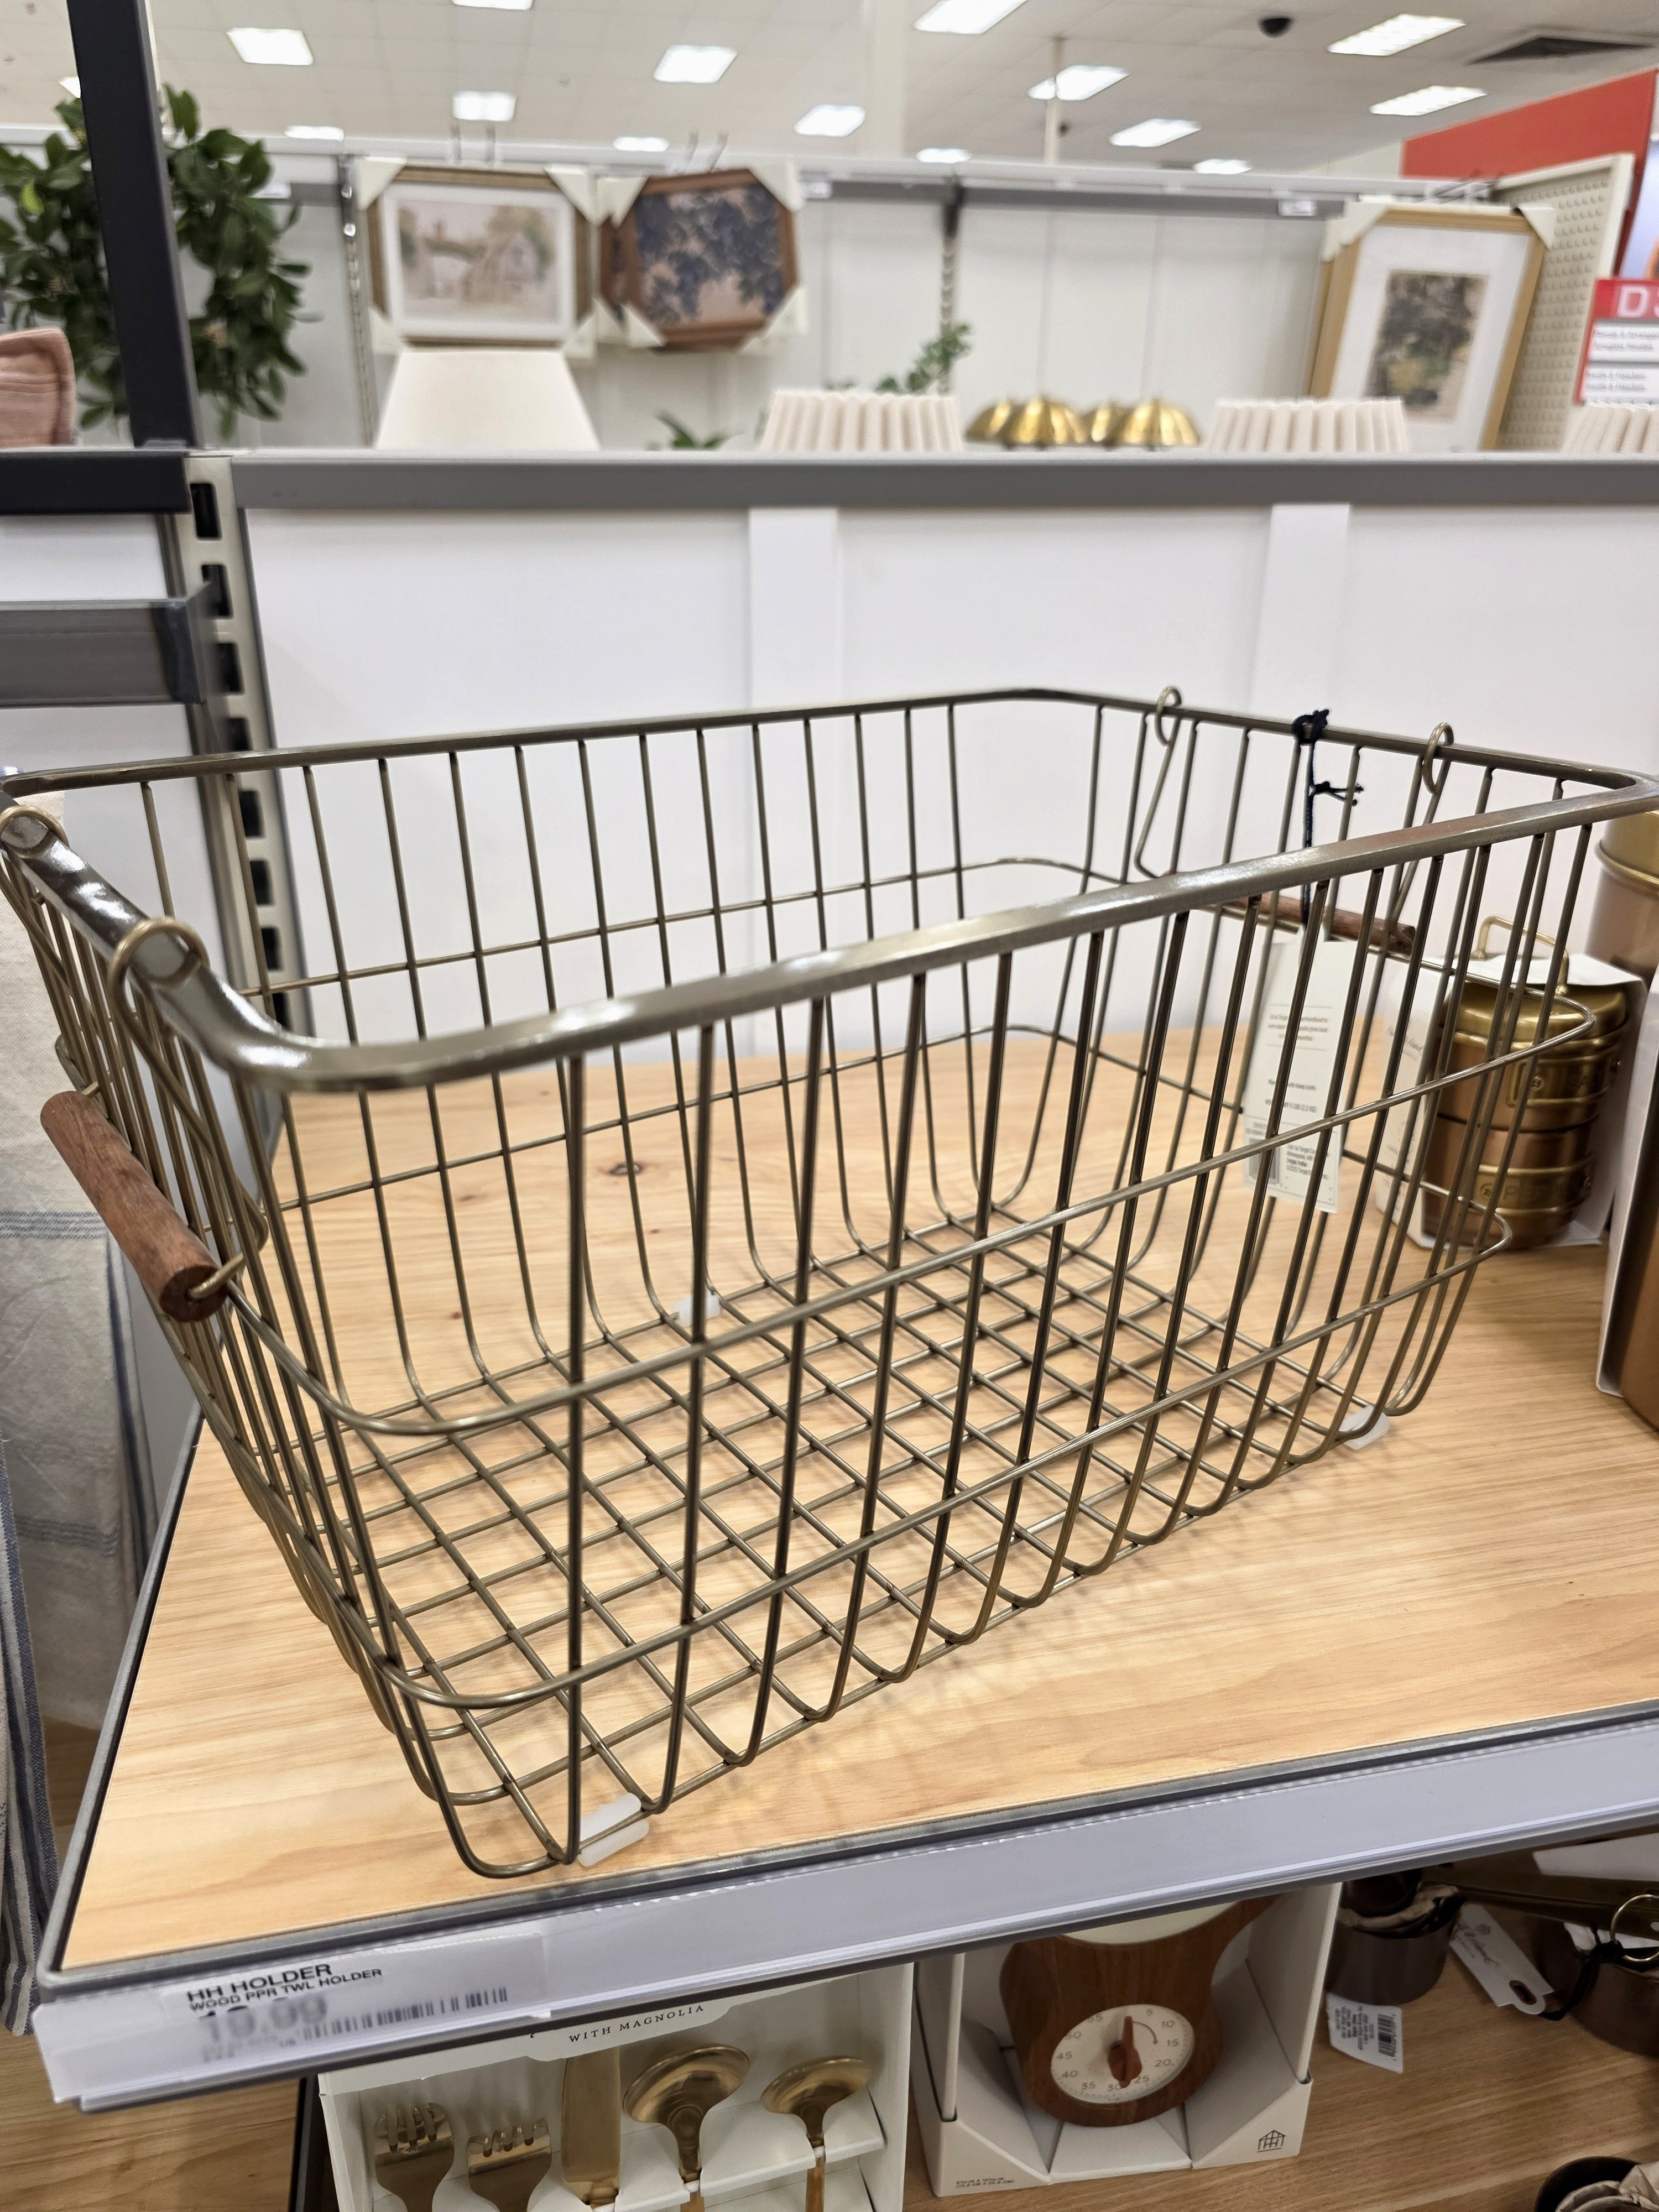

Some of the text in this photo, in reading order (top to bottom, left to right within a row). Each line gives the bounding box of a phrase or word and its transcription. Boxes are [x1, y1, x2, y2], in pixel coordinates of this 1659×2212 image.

[1617, 284, 1659, 319] D
[186, 1963, 332, 2002] HH HOLDER
[187, 1968, 383, 2011] WOOD PPR TWL HOLDER
[569, 2005, 704, 2043] WITH MAGNOLIA
[1161, 2020, 1175, 2028] 10
[1167, 2038, 1180, 2047] 15
[1056, 2051, 1073, 2060] 45
[1155, 2059, 1171, 2067] 20
[1134, 2075, 1150, 2084] 25
[1081, 2081, 1096, 2090] 35
